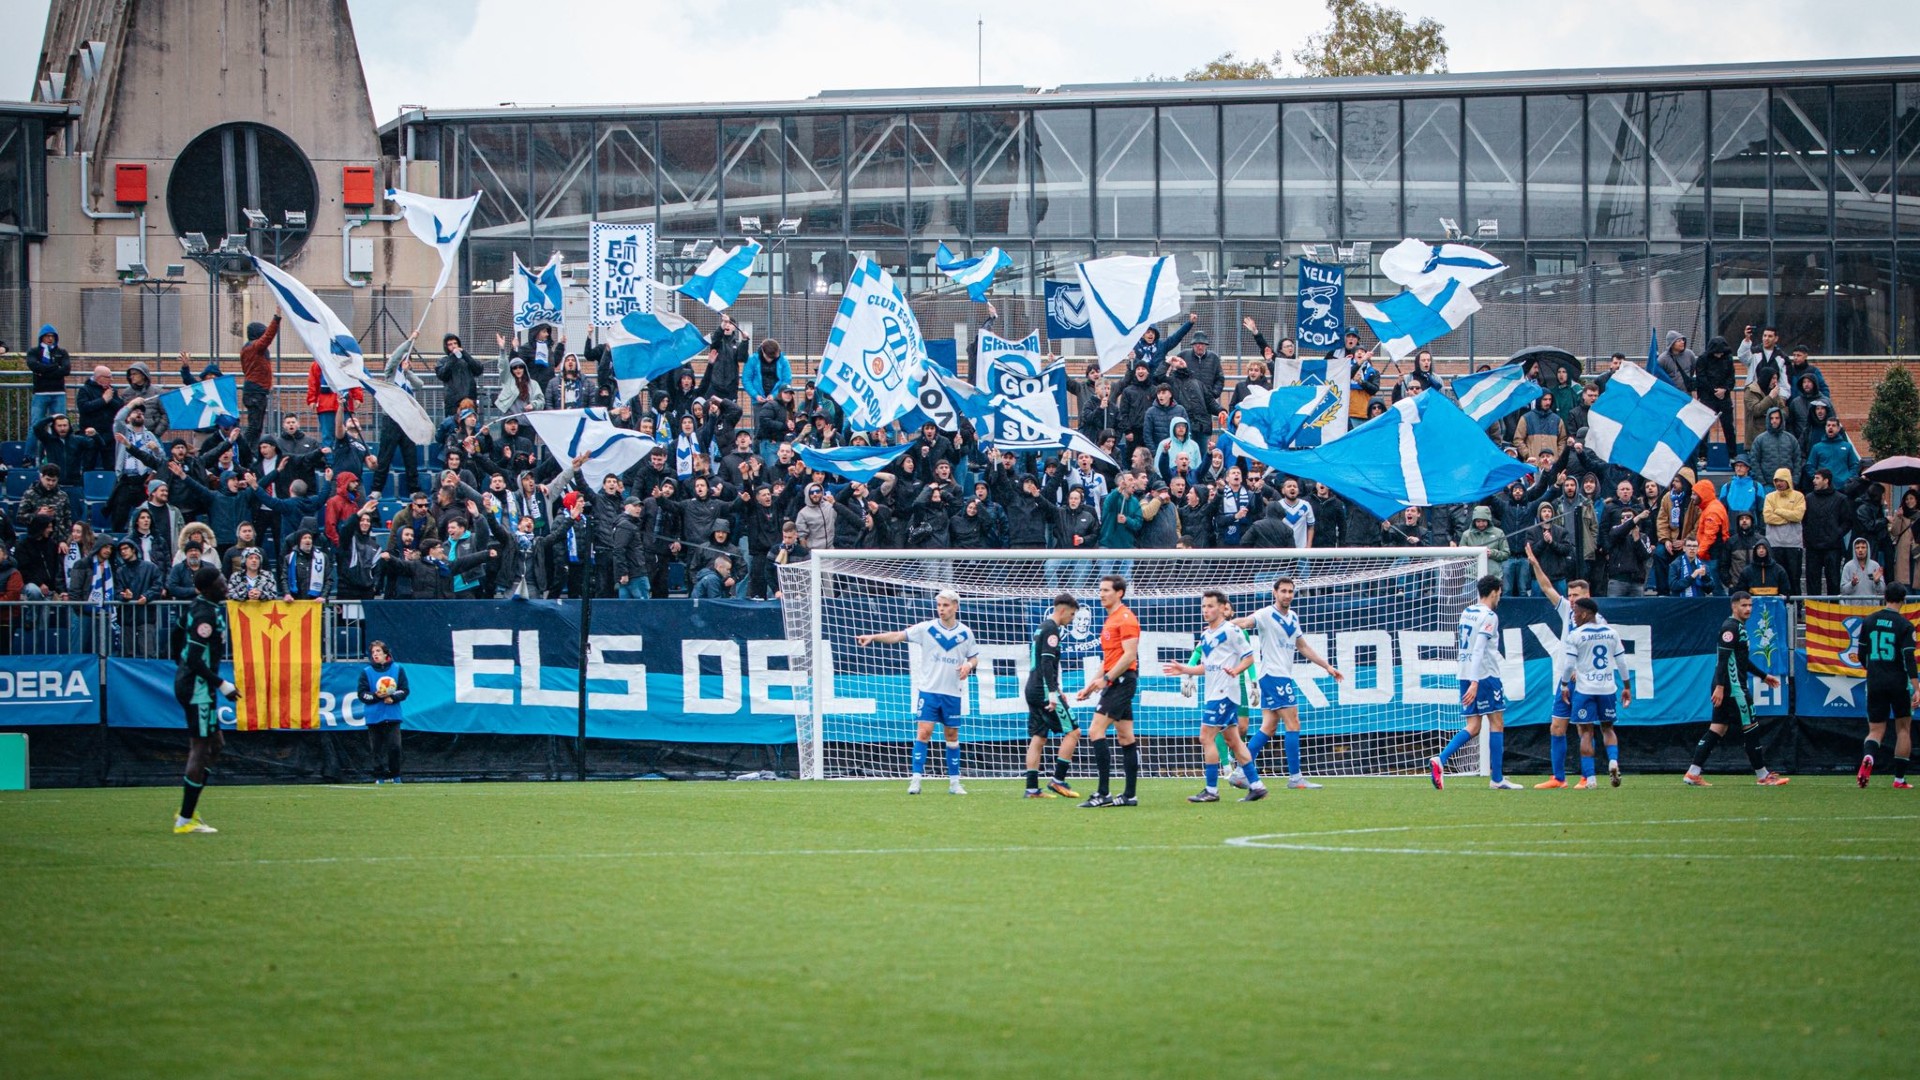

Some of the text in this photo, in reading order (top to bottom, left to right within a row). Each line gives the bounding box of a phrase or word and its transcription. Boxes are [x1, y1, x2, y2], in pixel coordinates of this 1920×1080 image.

[867, 294, 897, 312] CLUB
[836, 362, 882, 428] EUROPA
[1000, 373, 1058, 397] GOL
[1592, 645, 1608, 670] 8
[1869, 630, 1896, 661] 15
[451, 629, 648, 711] ELS
[1285, 683, 1293, 695] 6
